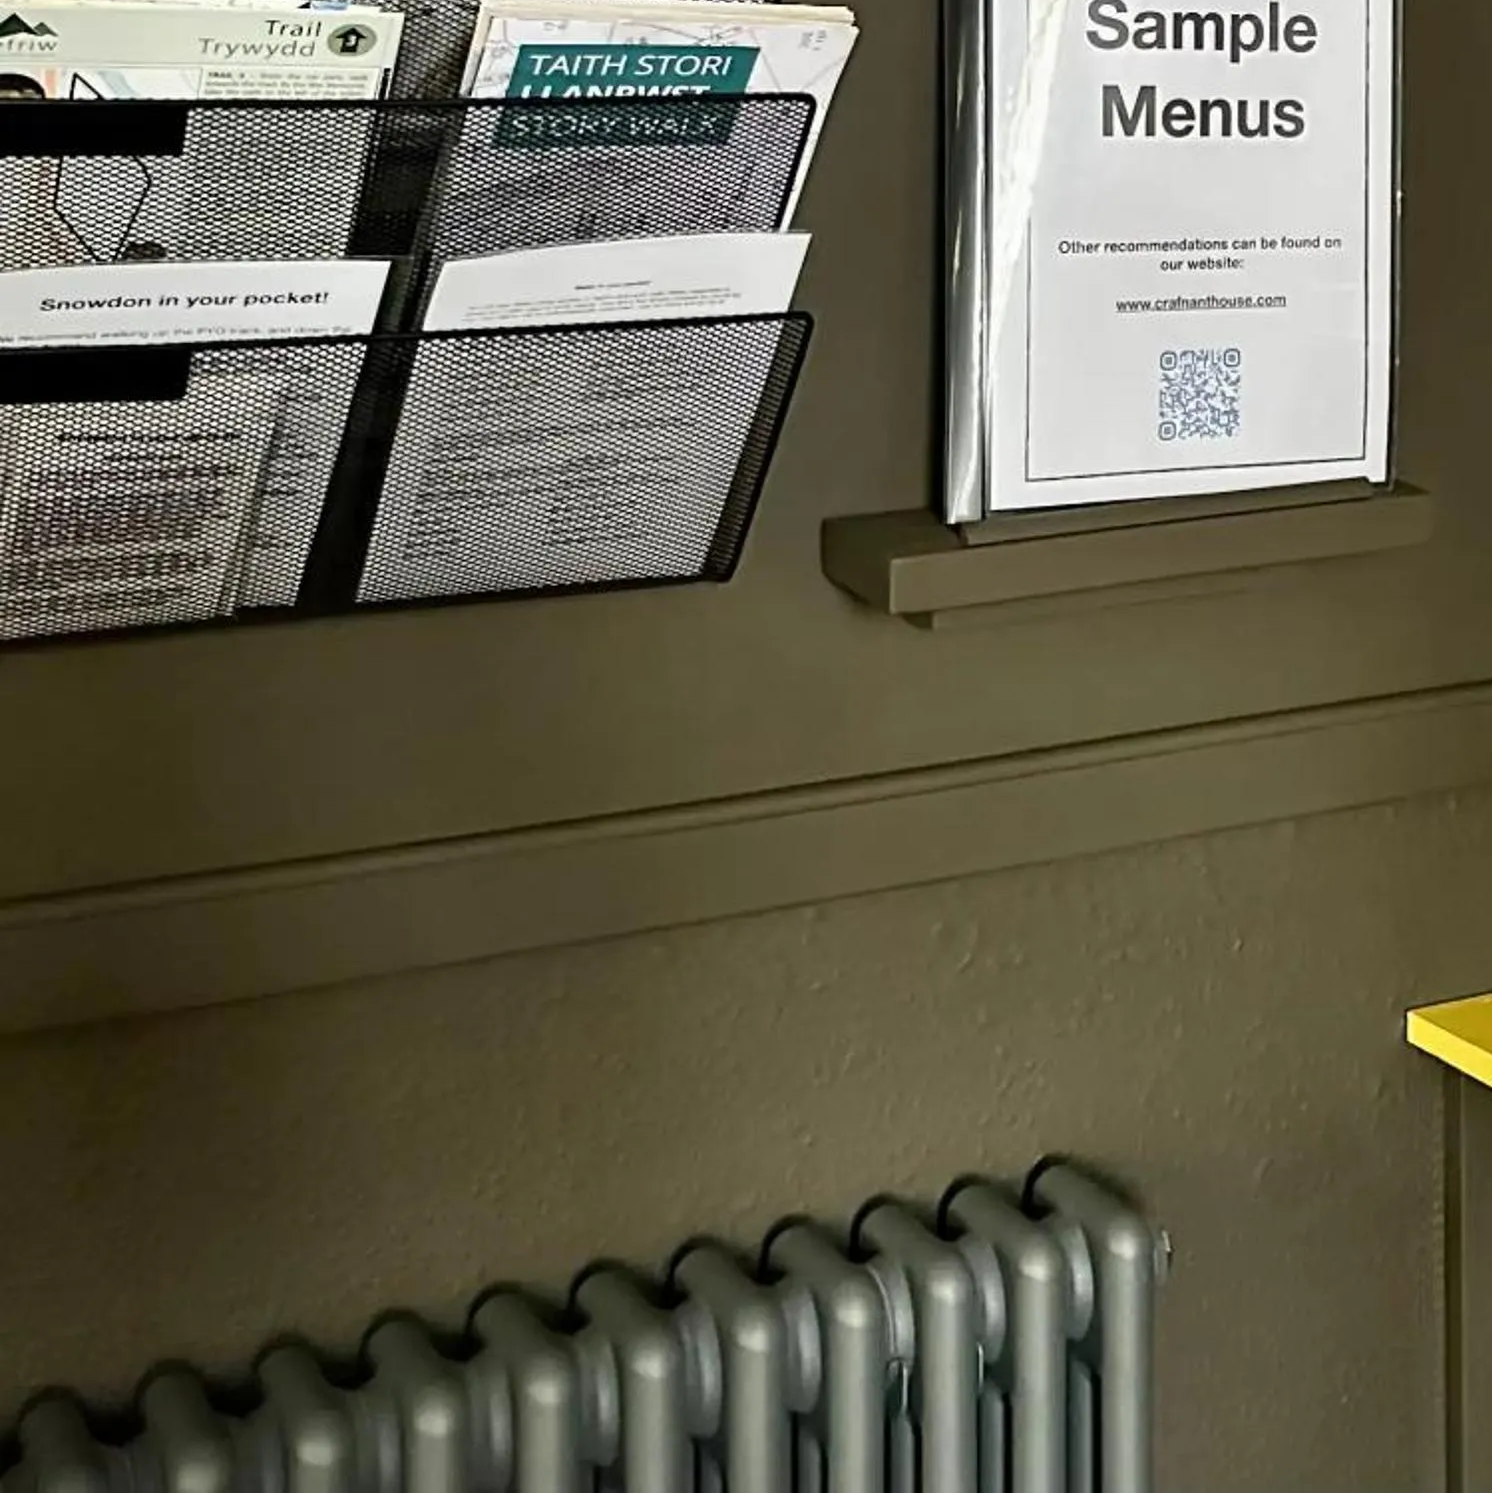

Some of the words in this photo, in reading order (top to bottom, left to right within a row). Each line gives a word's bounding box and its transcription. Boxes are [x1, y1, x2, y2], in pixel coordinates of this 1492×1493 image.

[266, 19, 324, 38] Trail
[198, 37, 316, 59] Trywydd
[530, 54, 627, 77] TAITH
[633, 54, 734, 77] STORI
[1101, 84, 1305, 139] Menus
[1058, 240, 1100, 255] Other
[1104, 237, 1228, 253] recommendations
[1232, 239, 1257, 250] can
[1260, 237, 1278, 250] be
[1281, 236, 1321, 249] found
[1160, 259, 1182, 271] our
[1188, 255, 1244, 270] website:
[39, 296, 152, 312] Snowdon
[158, 295, 179, 308] in
[186, 292, 238, 311] your
[243, 290, 329, 309] pocket!
[1116, 294, 1287, 313] www.crafnanthouse.com
